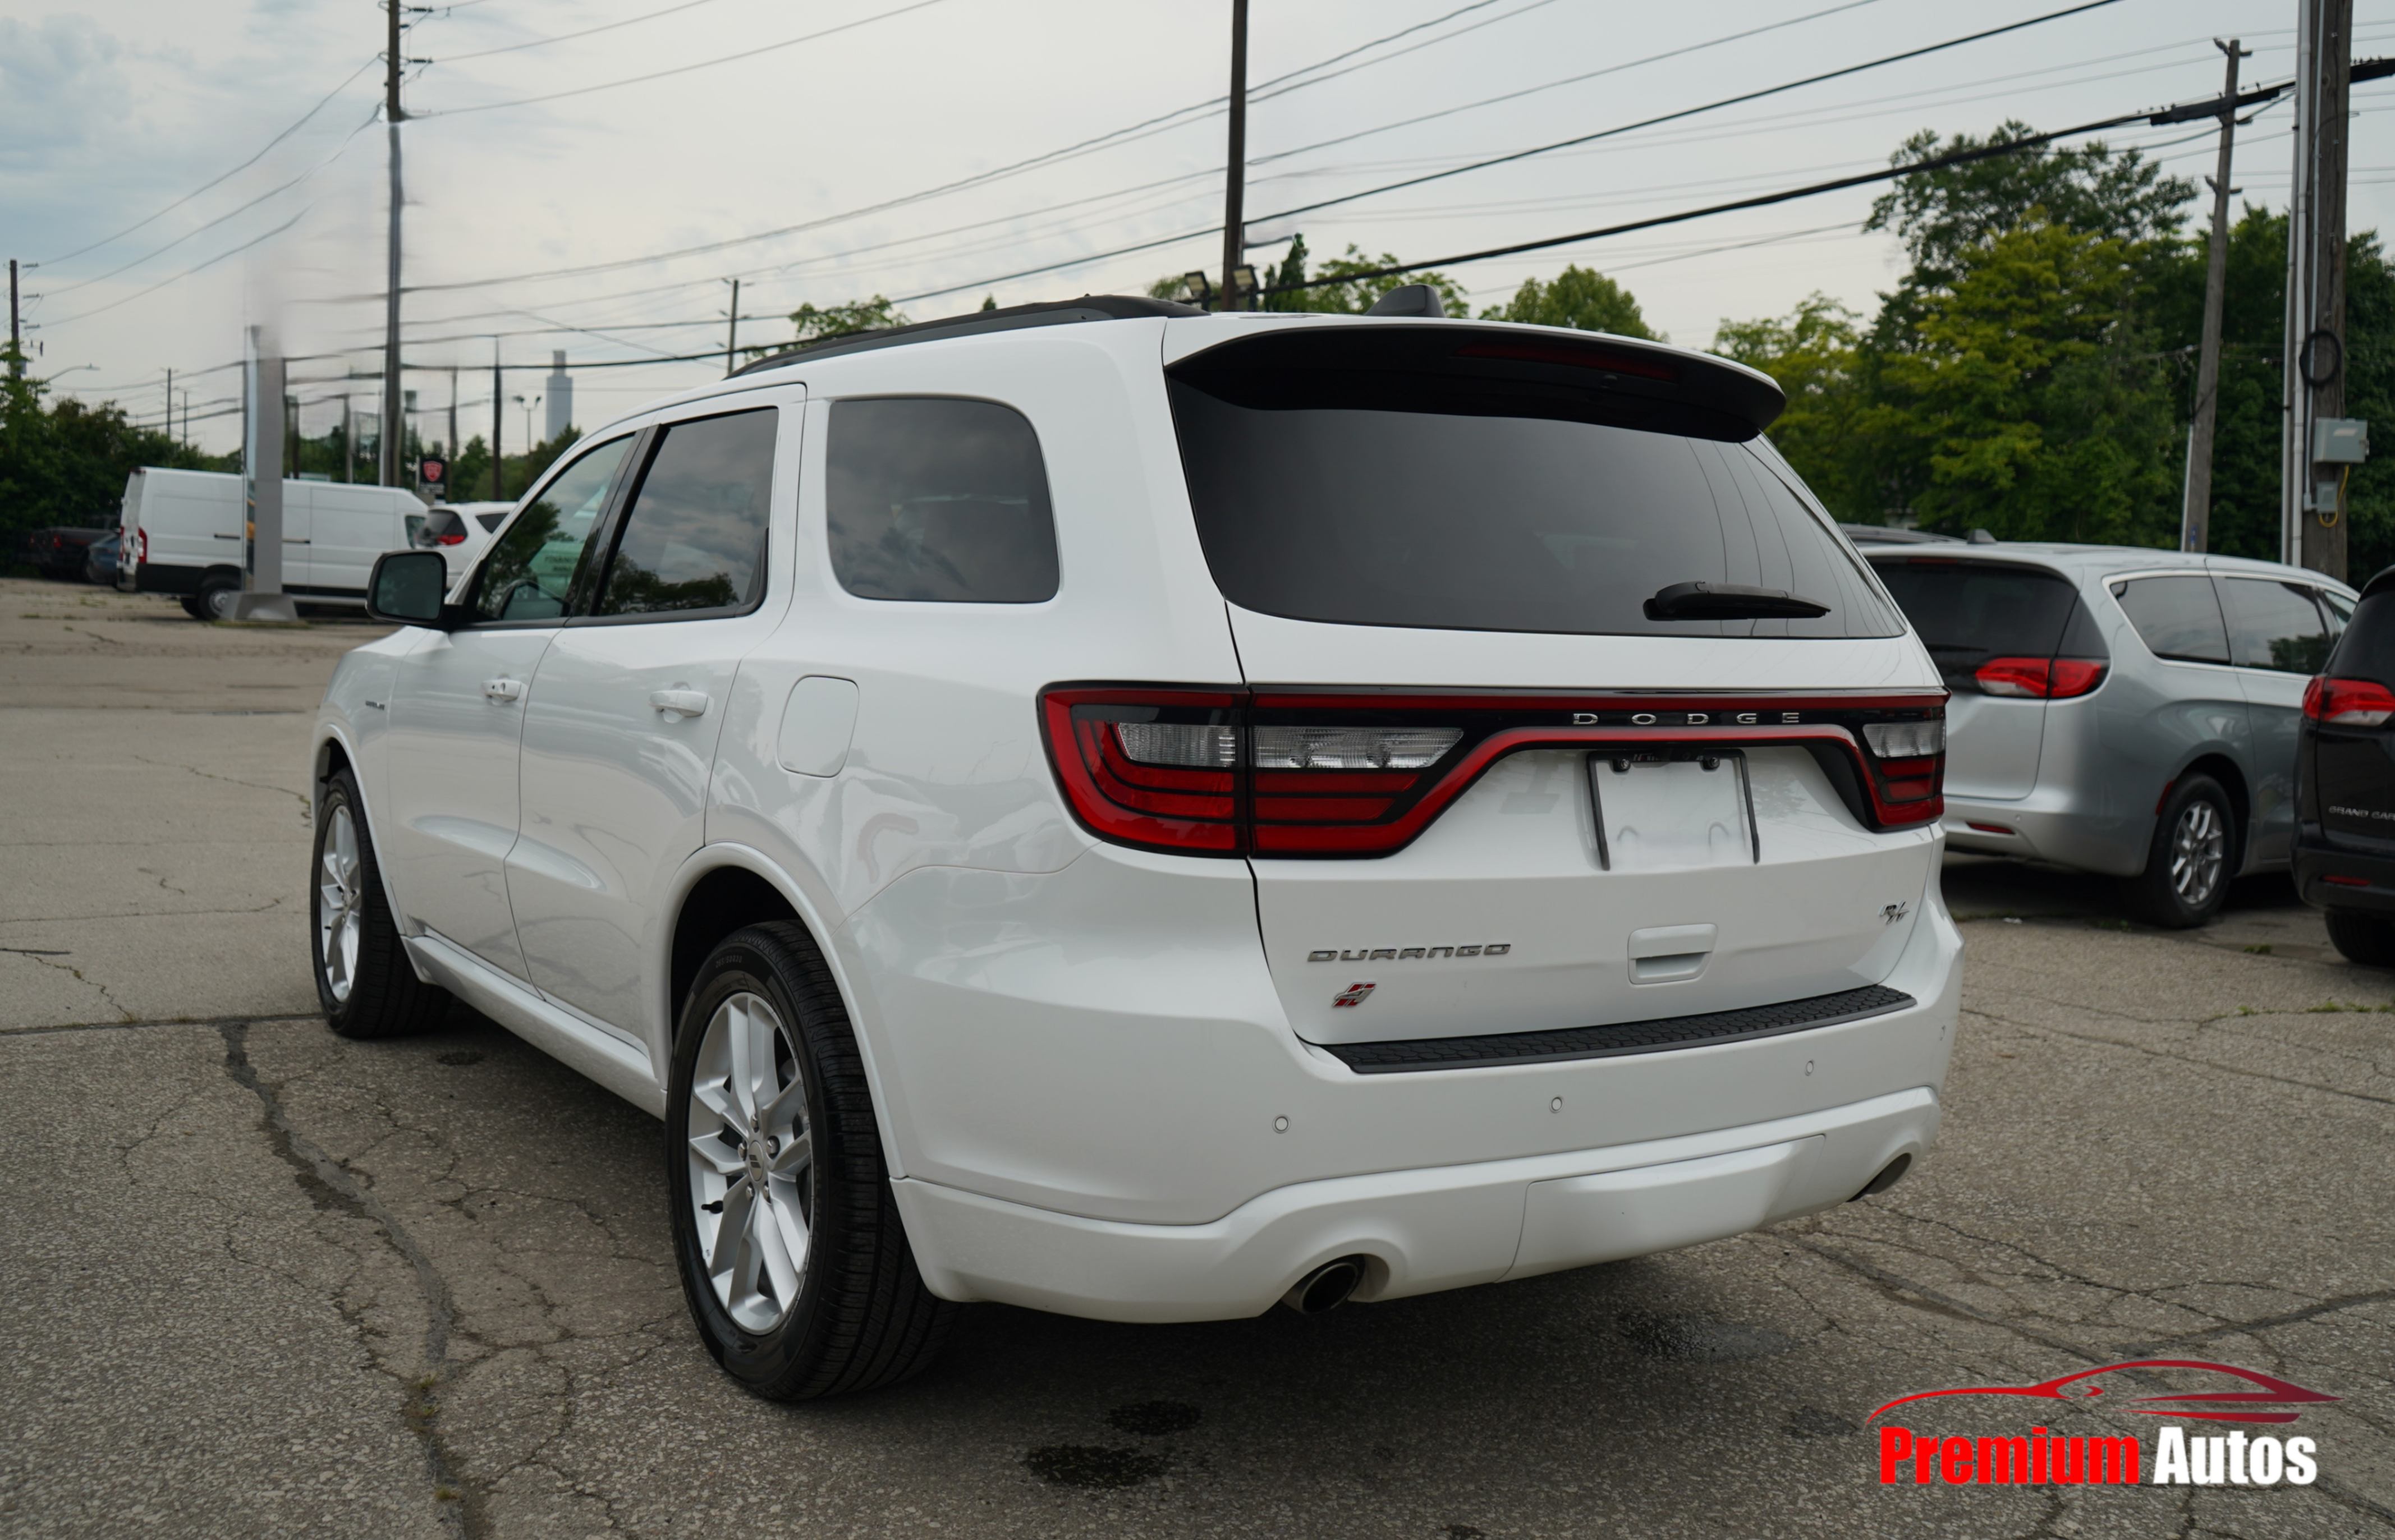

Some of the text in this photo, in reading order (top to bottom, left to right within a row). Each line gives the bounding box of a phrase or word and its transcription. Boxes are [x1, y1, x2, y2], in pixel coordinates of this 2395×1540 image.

[1572, 711, 1800, 725] DODGE
[2328, 805, 2369, 818] GRAND
[1307, 943, 1511, 962] DURANGO
